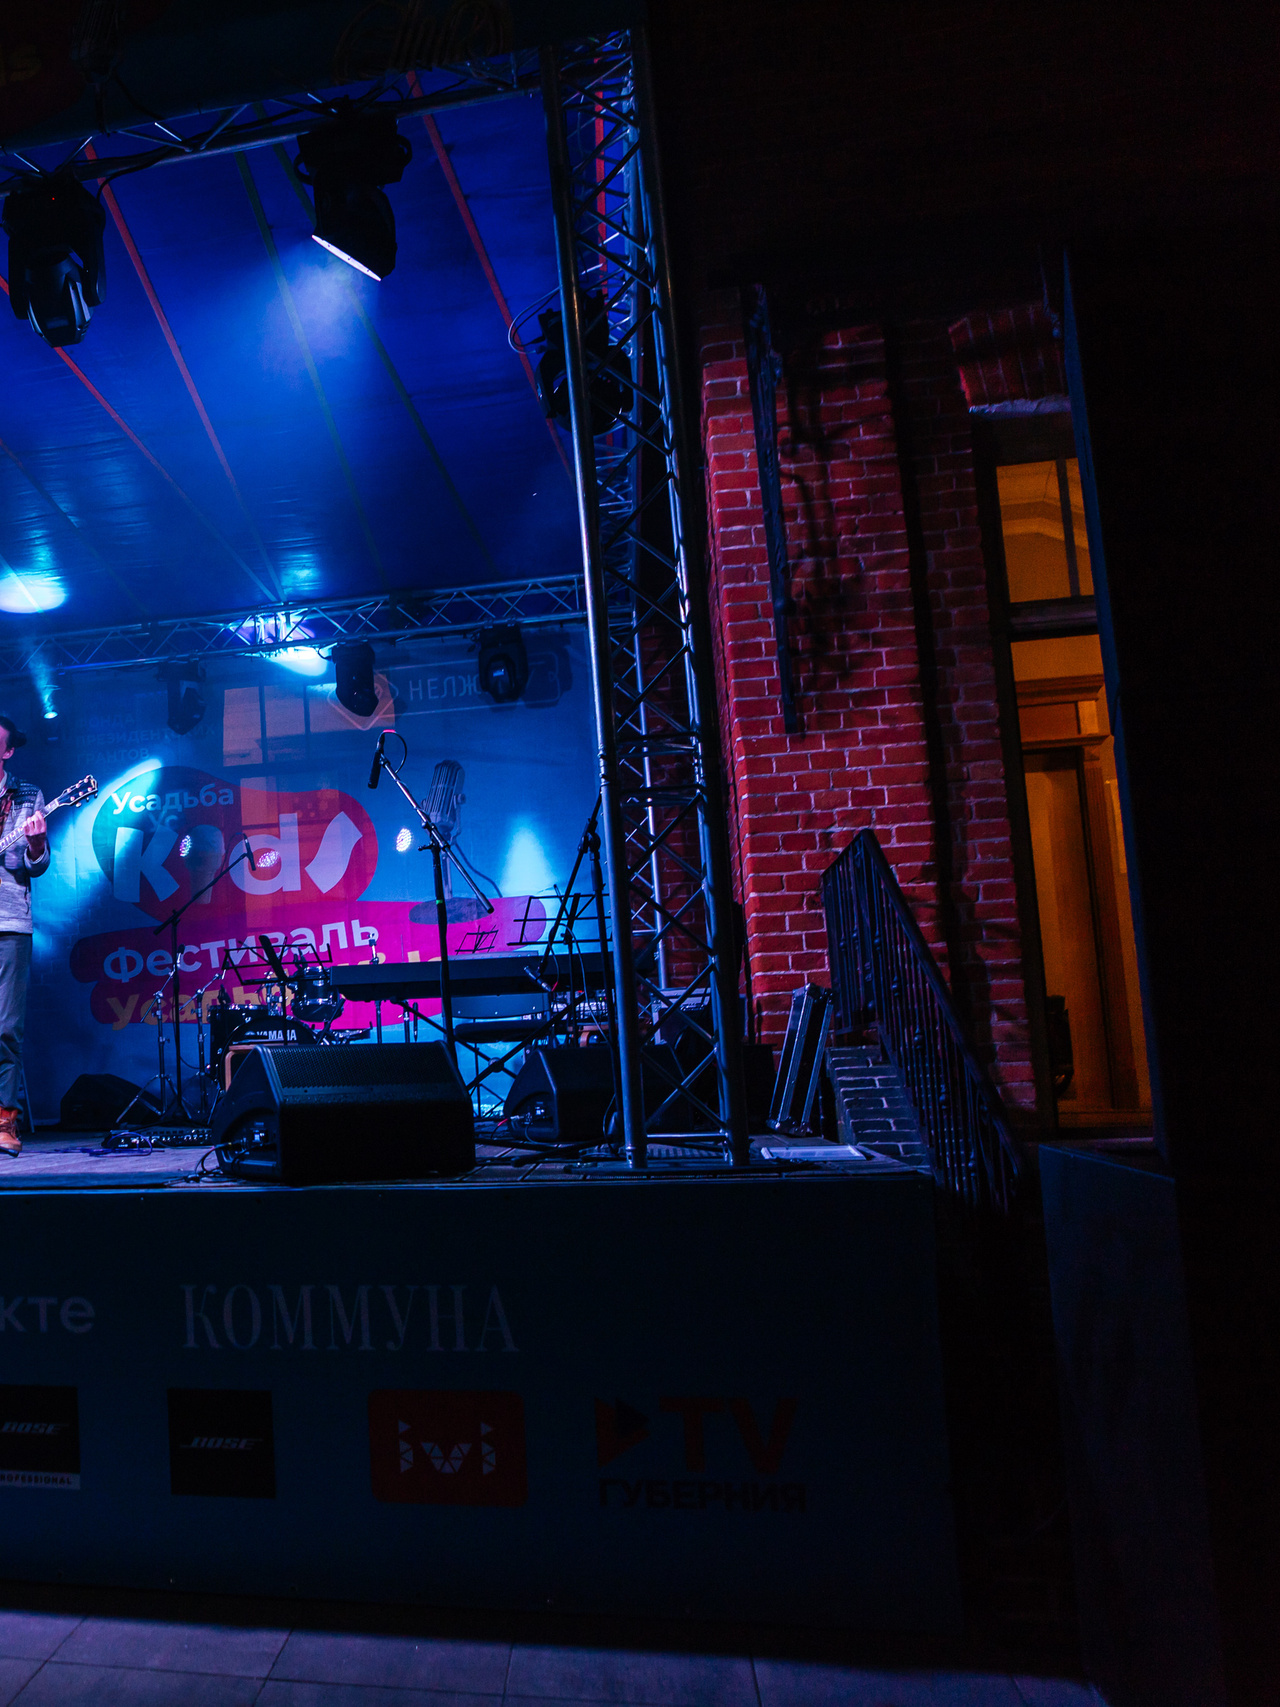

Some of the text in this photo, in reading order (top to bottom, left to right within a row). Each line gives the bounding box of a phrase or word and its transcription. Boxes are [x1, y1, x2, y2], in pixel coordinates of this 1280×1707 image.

[76, 747, 150, 765] ГРАНТОВ
[111, 784, 234, 815] Усадьба
[103, 919, 379, 983] Фестиваль
[179, 1283, 521, 1353] КОММУНА
[179, 1436, 264, 1451] BOSE
[658, 1396, 800, 1475] TV
[597, 1477, 808, 1514] ГУБЕРНИЯ
